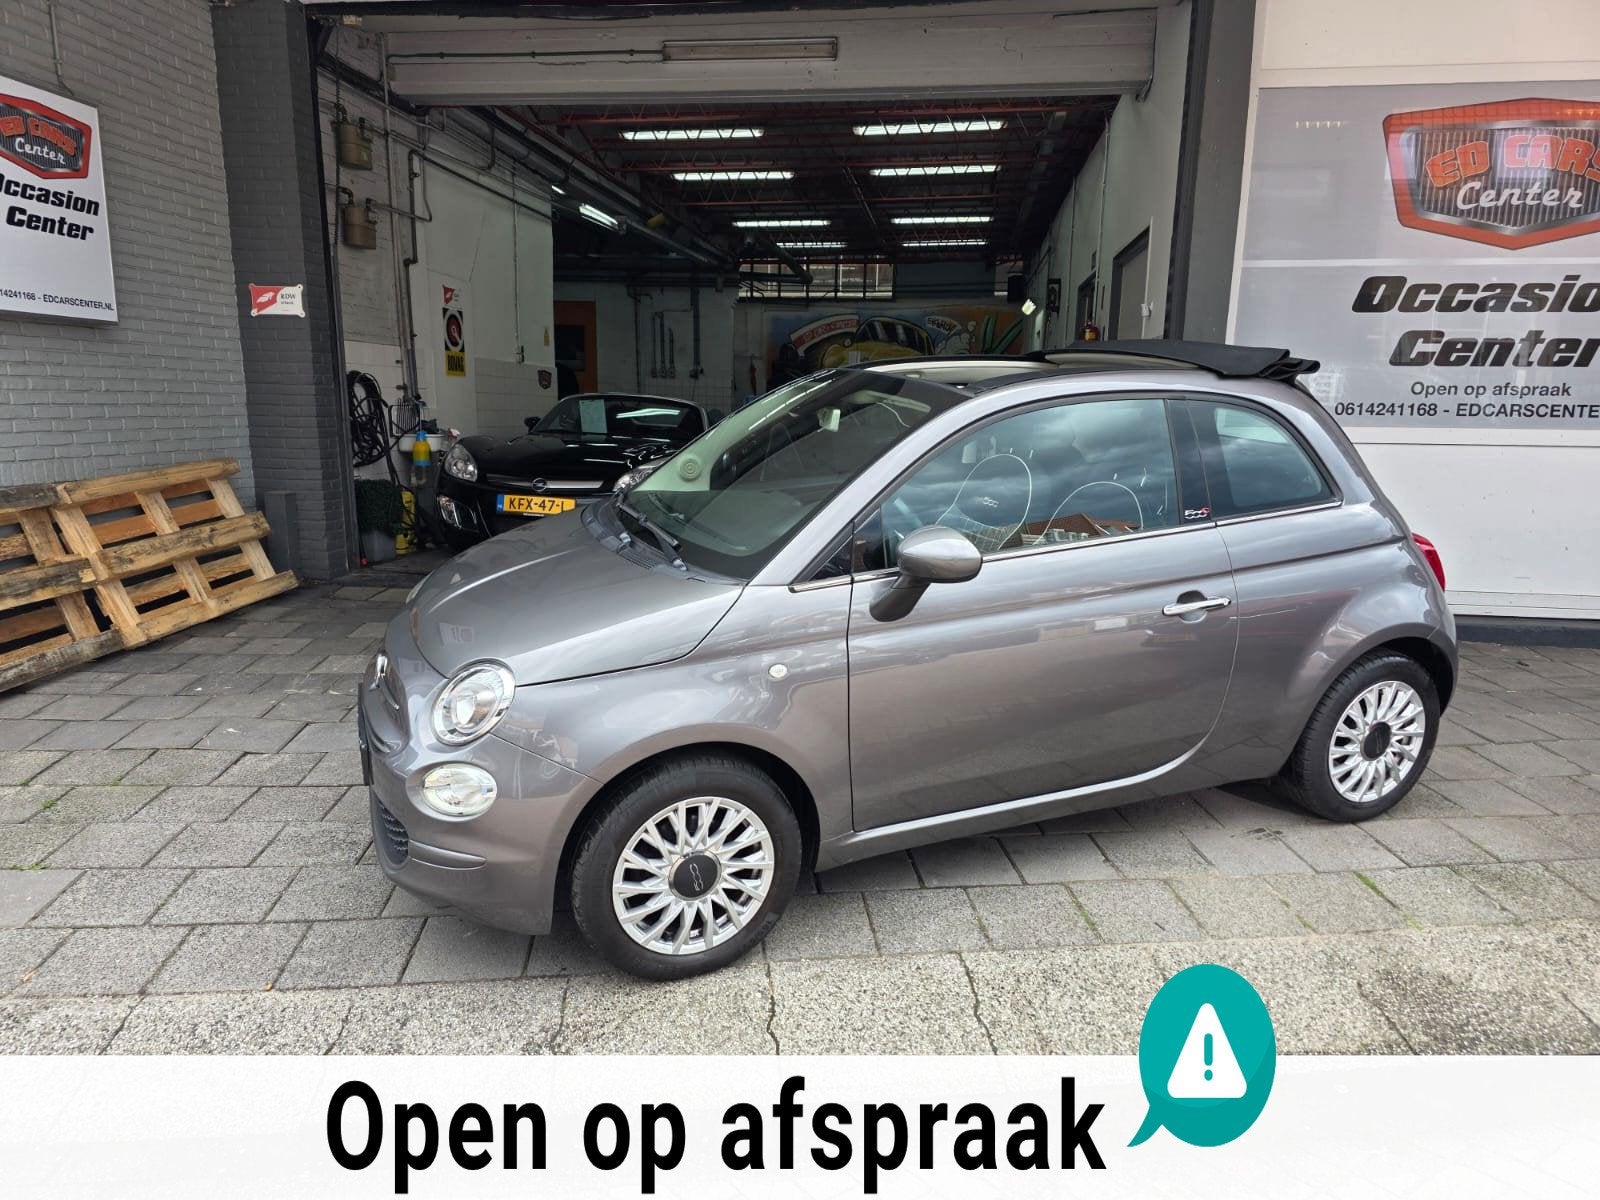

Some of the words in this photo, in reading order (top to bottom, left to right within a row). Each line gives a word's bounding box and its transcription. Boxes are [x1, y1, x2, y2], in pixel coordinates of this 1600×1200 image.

[15, 137, 66, 165] Center
[1426, 141, 1490, 187] ED
[0, 173, 100, 216] ccasion
[1456, 181, 1583, 210] Center
[6, 205, 94, 241] Center
[1351, 274, 1600, 313] Occasio
[1388, 330, 1600, 368] Center
[1410, 381, 1458, 398] Open
[1463, 386, 1487, 399] op
[1492, 382, 1572, 399] afspraak
[1334, 402, 1438, 417] 0614241168
